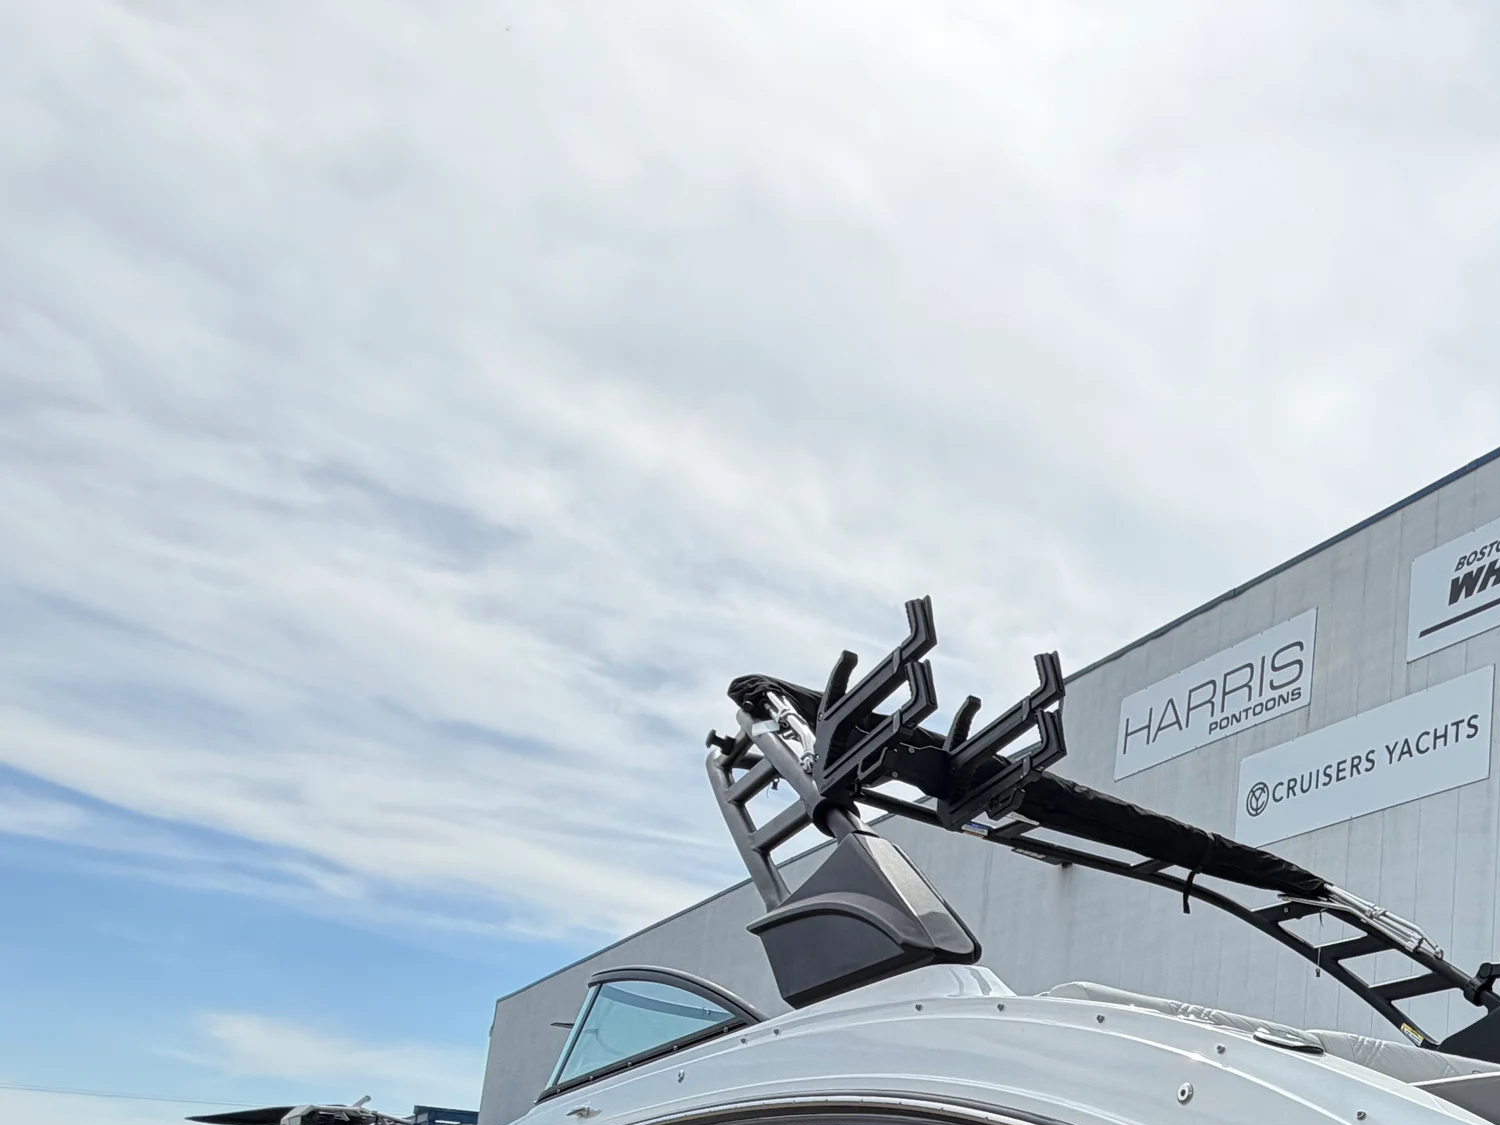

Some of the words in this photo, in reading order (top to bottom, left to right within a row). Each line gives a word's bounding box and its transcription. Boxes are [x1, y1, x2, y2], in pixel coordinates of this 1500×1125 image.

[1122, 640, 1304, 756] HARRIS
[1208, 687, 1302, 735] PONTOONS
[1272, 749, 1376, 803] CRUISERS
[1384, 714, 1479, 765] YACHTS
